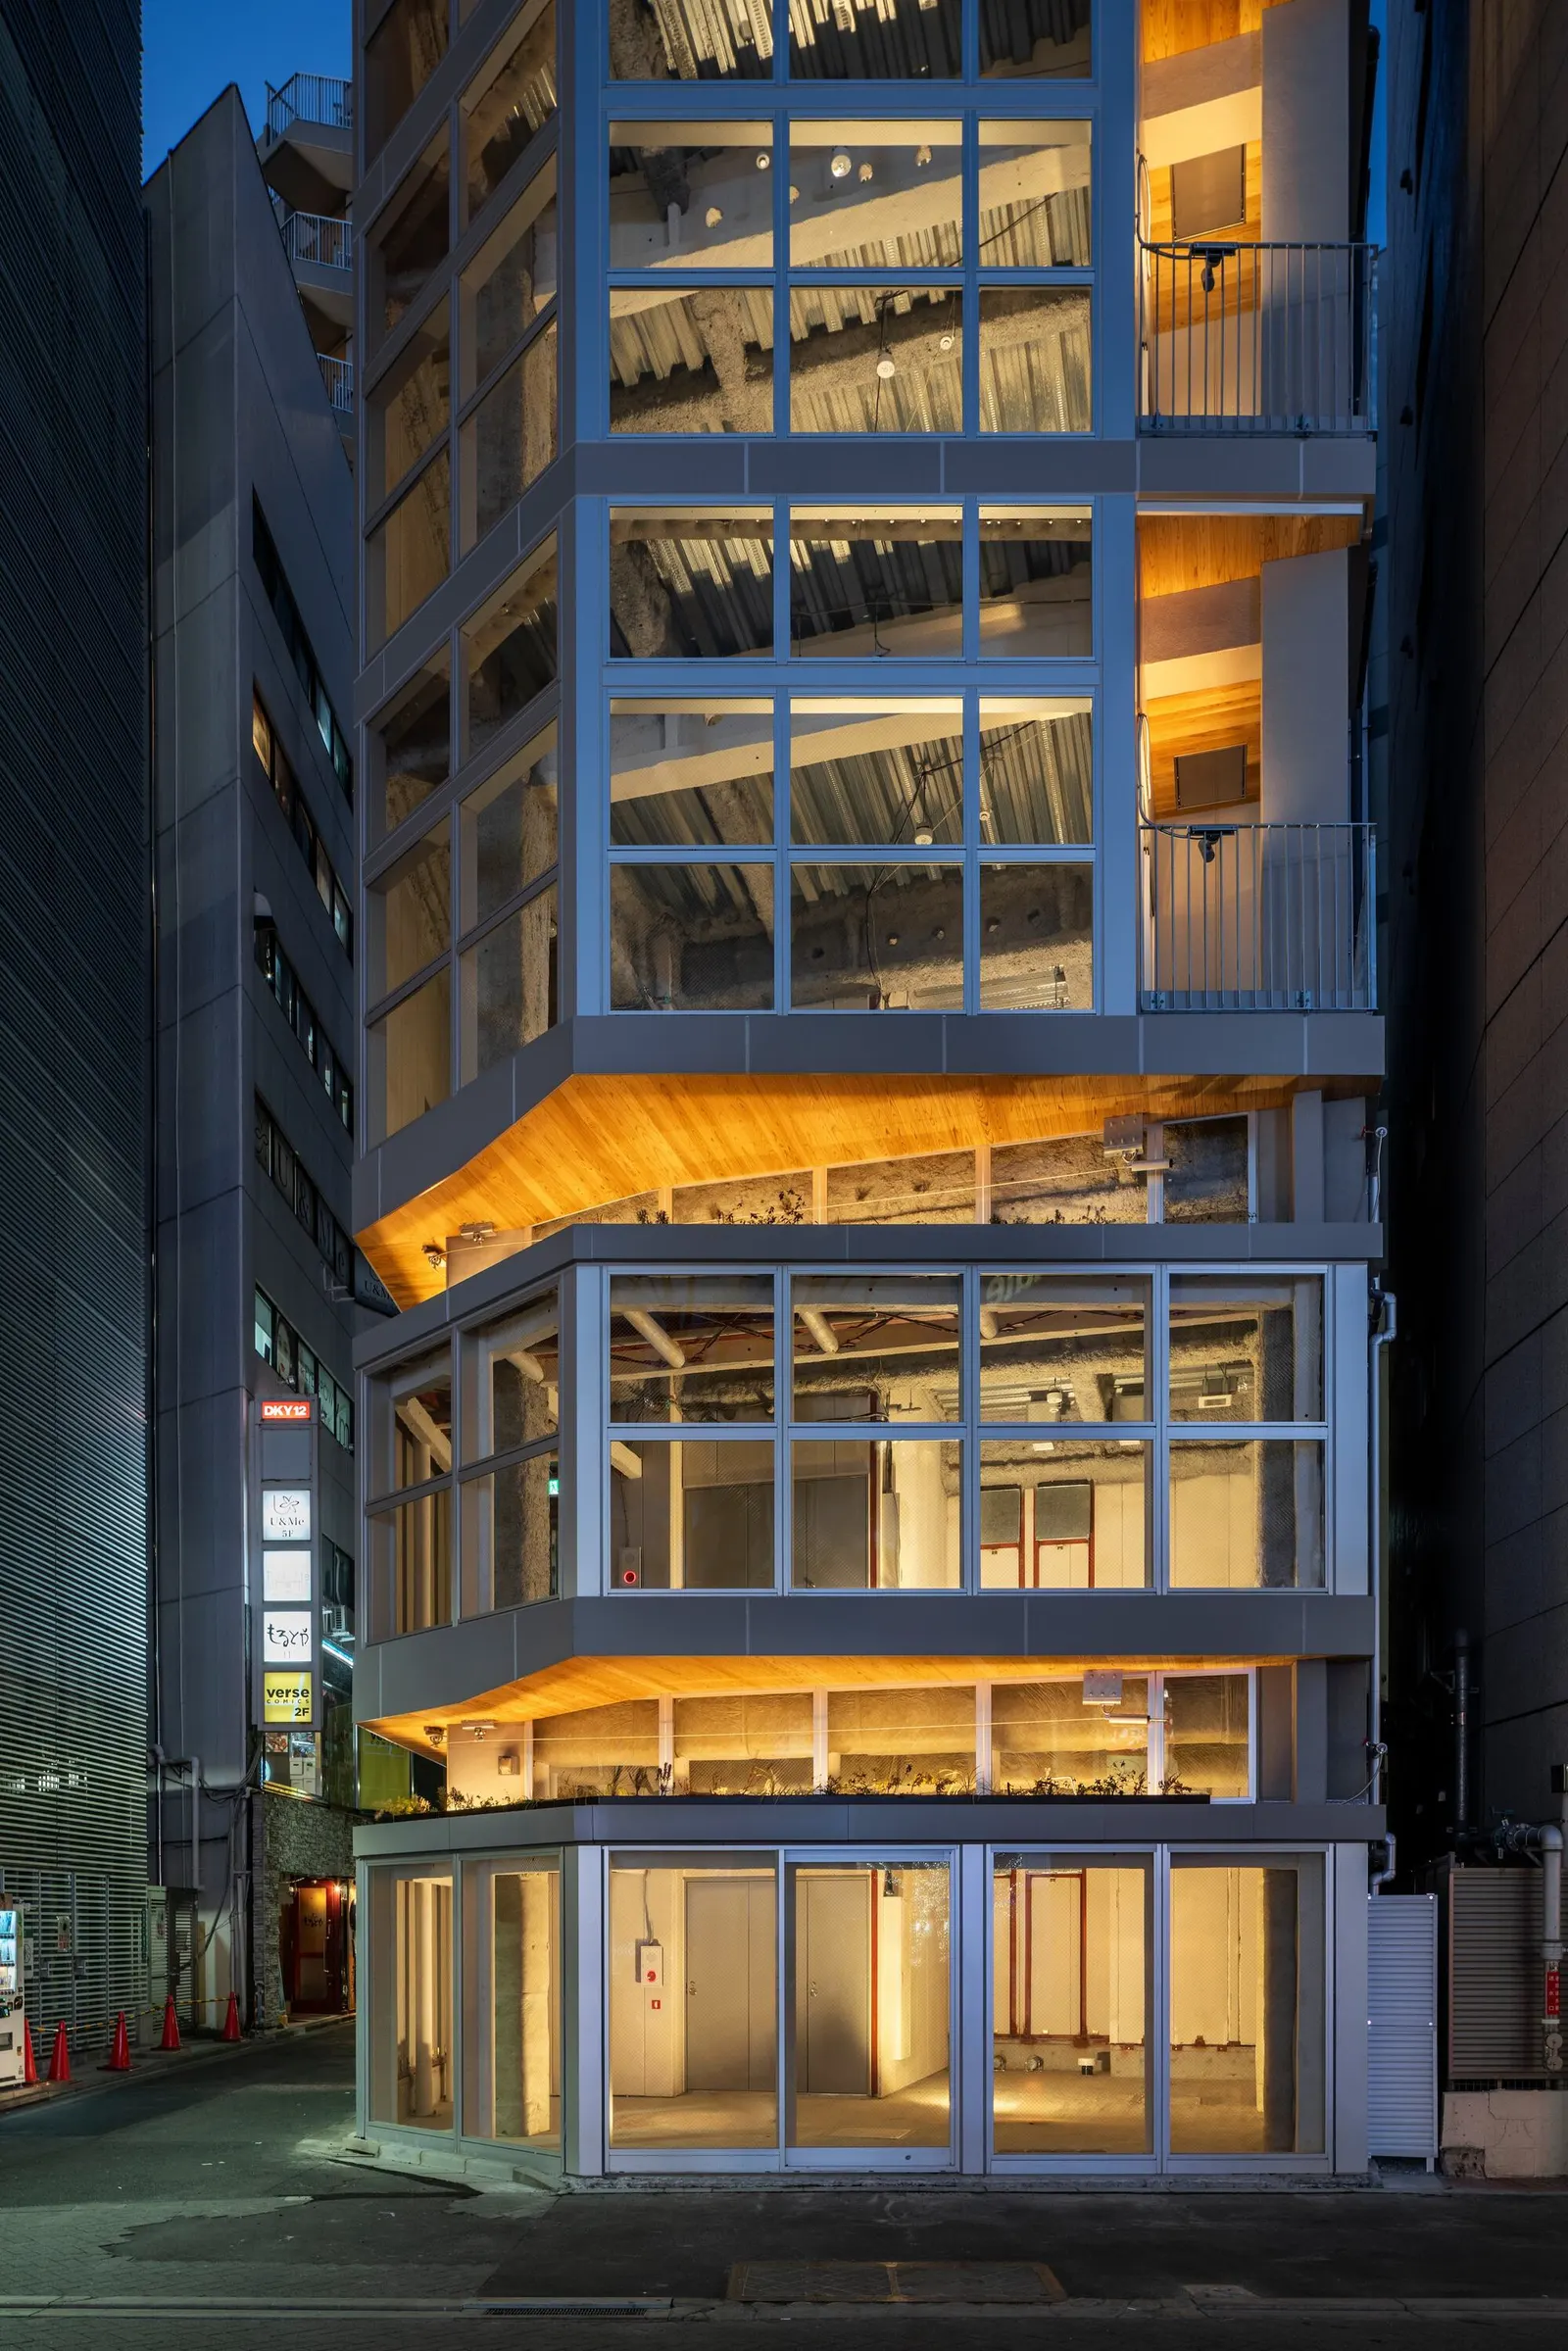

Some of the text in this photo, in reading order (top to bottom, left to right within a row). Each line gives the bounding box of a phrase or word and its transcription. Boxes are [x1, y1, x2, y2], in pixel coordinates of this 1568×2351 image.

[264, 1405, 307, 1416] DKY12
[266, 1689, 310, 1698] verse
[294, 1707, 310, 1717] 2F
